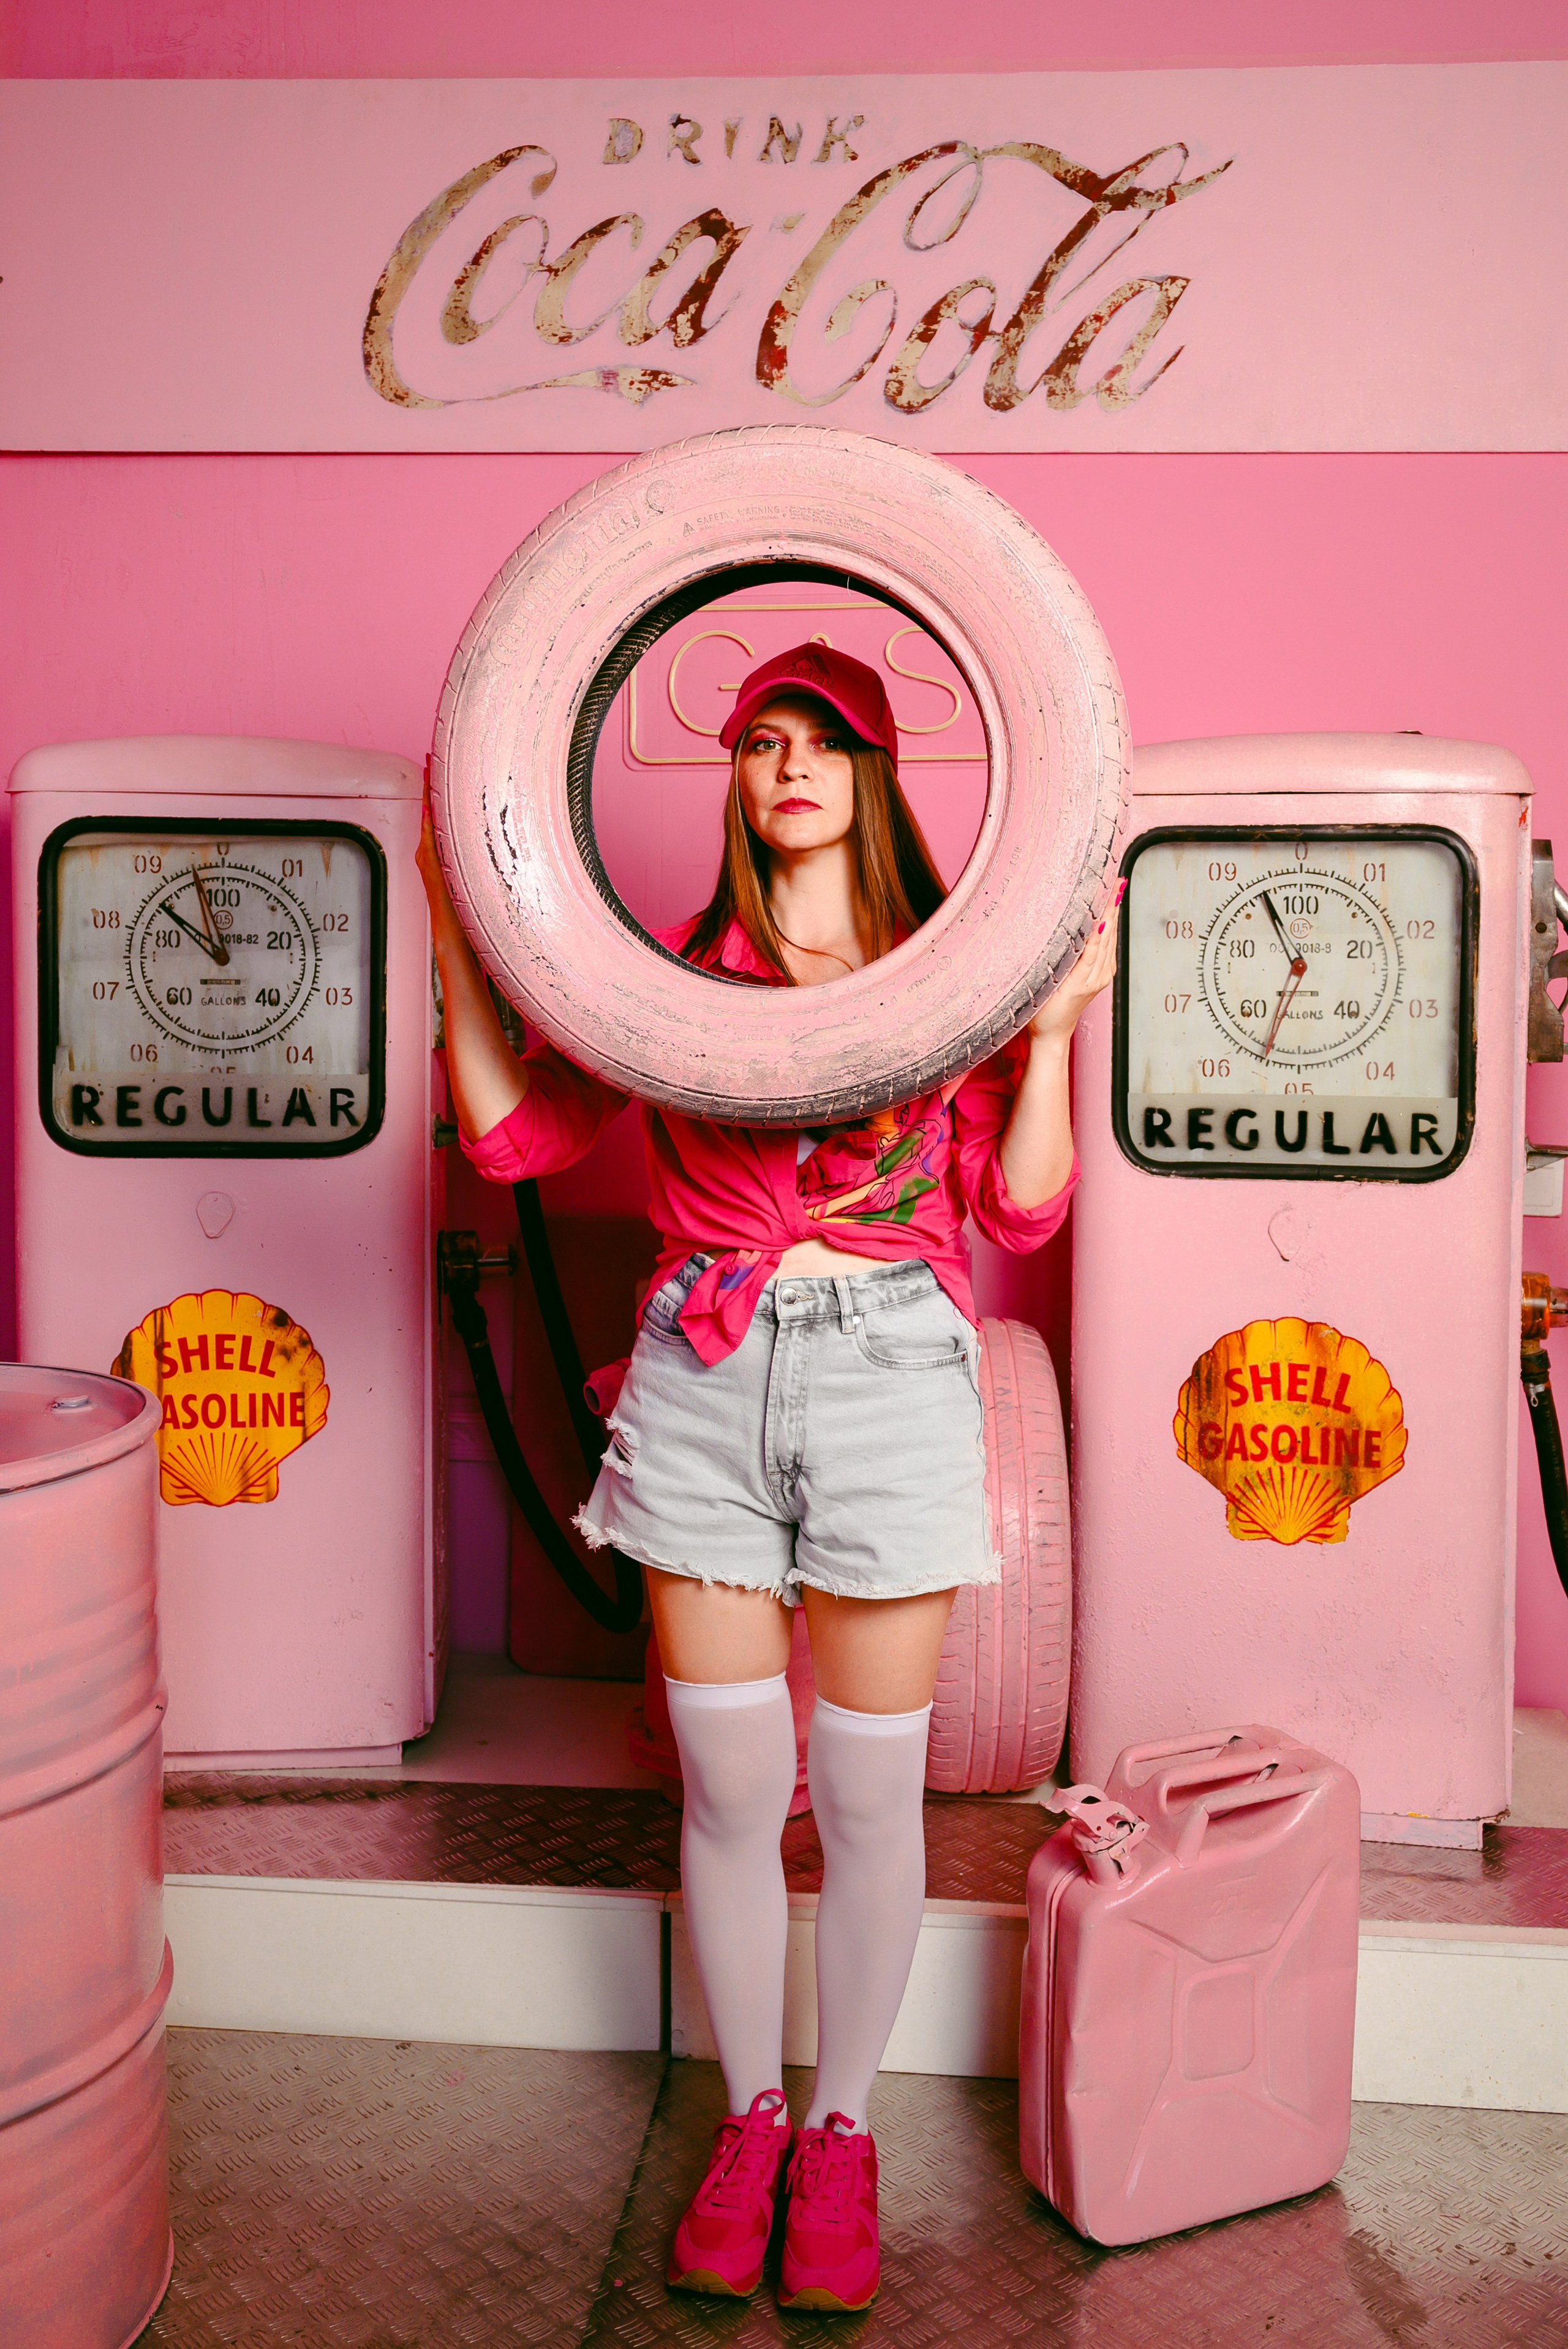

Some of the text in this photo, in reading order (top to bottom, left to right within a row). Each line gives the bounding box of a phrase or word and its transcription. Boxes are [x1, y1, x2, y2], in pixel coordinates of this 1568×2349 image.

[602, 113, 868, 166] DRINK
[668, 626, 962, 736] GS
[134, 855, 162, 874] 09
[282, 859, 303, 877] 01
[1208, 862, 1237, 882] 09
[1363, 862, 1386, 883] 01
[205, 888, 241, 908] 100
[1283, 895, 1319, 915] 100
[92, 910, 120, 930] 08
[215, 914, 232, 926] 0,5
[323, 913, 349, 932] 02
[1406, 920, 1436, 940] 02
[155, 930, 181, 949] 80
[266, 931, 292, 950] 20
[1166, 921, 1194, 940] 08
[1229, 940, 1255, 959] 80
[1347, 940, 1373, 959] 20
[92, 981, 119, 1001] 07
[166, 987, 192, 1006] 60
[255, 987, 281, 1007] 40
[325, 987, 353, 1006] 03
[1164, 994, 1192, 1014] 07
[1240, 999, 1267, 1019] 60
[1333, 1000, 1360, 1020] 40
[1409, 999, 1439, 1019] 03
[130, 1043, 158, 1063] 06
[286, 1046, 314, 1065] 04
[1202, 1058, 1231, 1078] 06
[1366, 1061, 1395, 1081] 04
[71, 1084, 361, 1128] REGULAR
[1144, 1107, 1444, 1155] REGULAR
[153, 1333, 276, 1379] SHELL
[1225, 1362, 1352, 1414] SHELL
[159, 1391, 306, 1430] ASOLINE
[1197, 1421, 1382, 1469] GASOLINE
